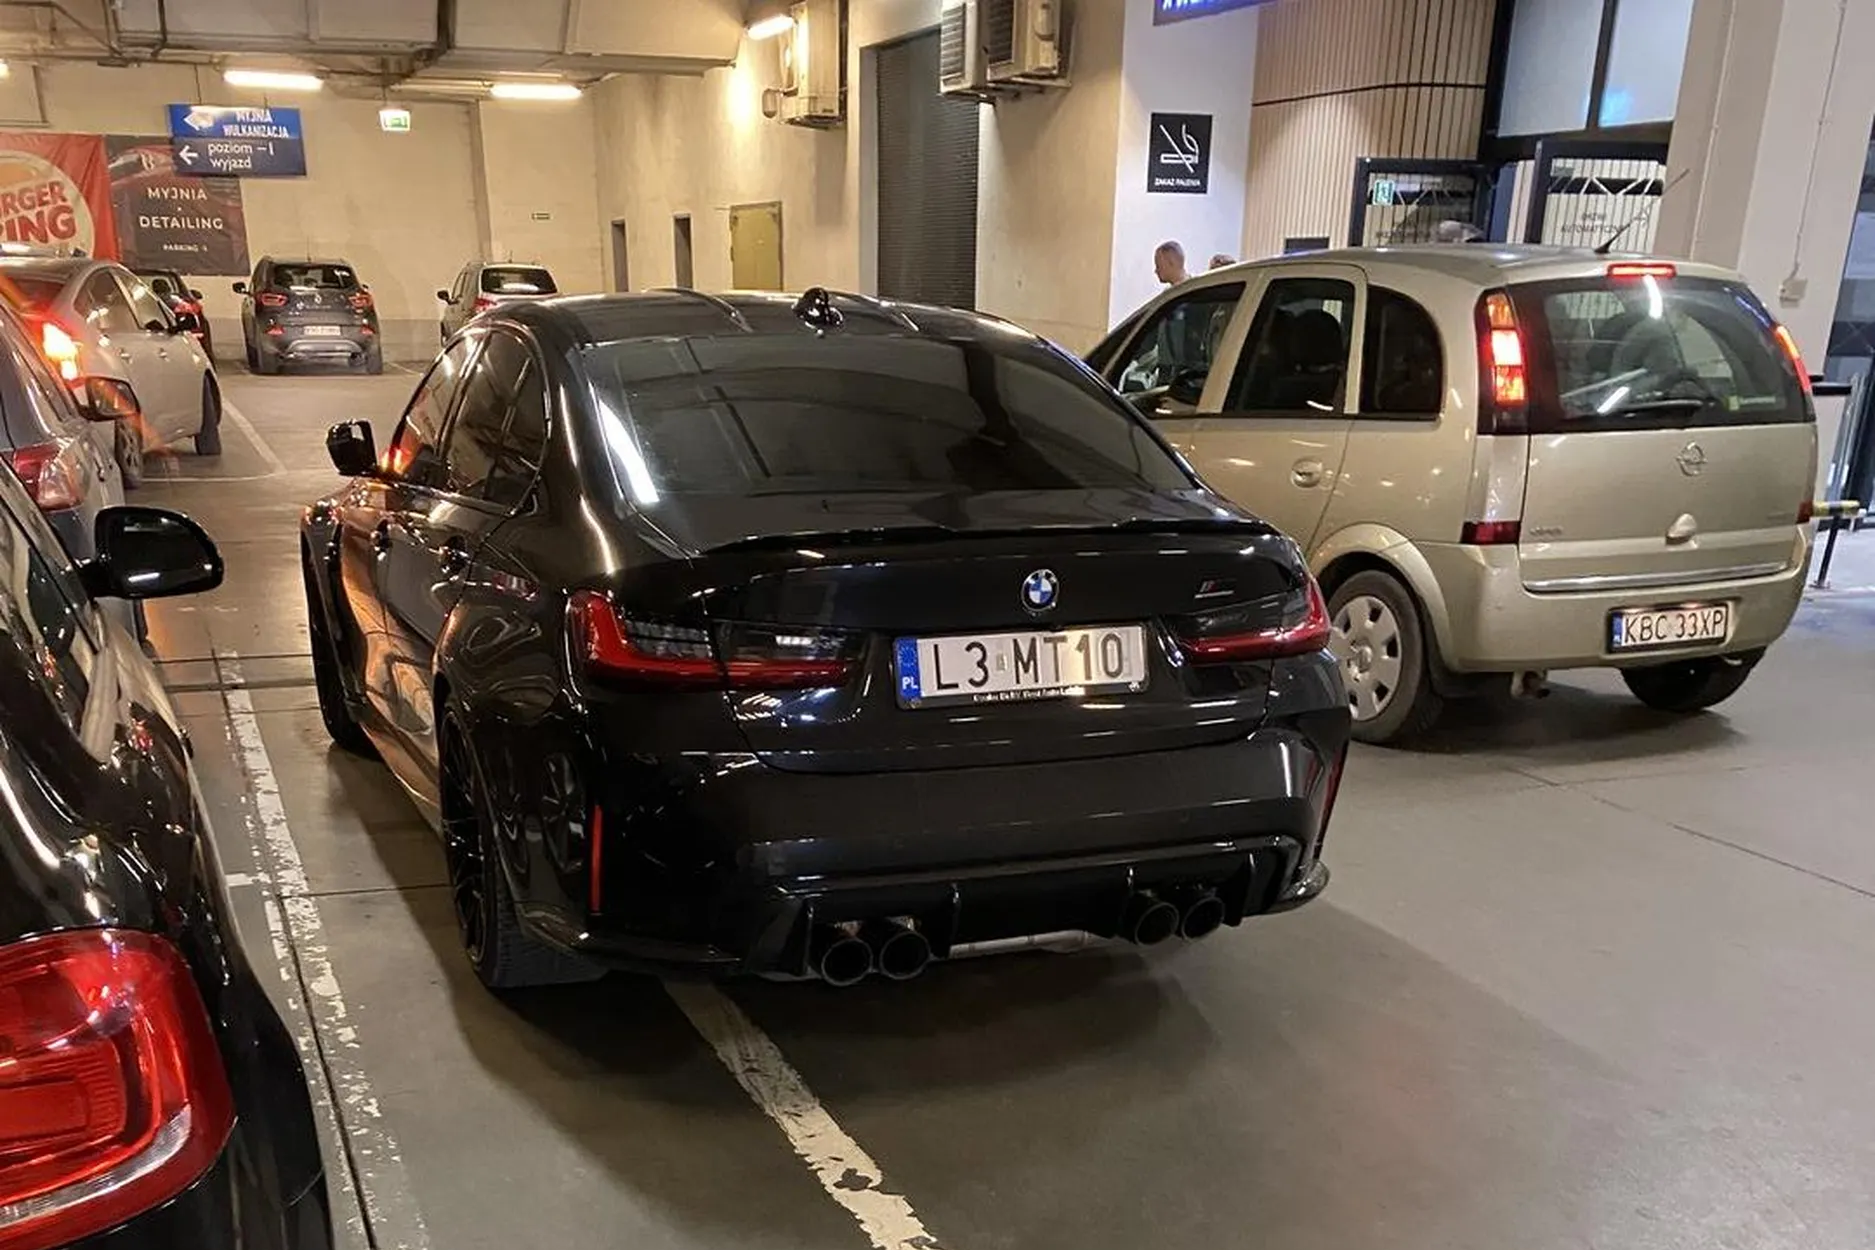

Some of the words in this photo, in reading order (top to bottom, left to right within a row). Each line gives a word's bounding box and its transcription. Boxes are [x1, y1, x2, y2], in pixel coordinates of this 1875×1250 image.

[222, 124, 290, 138] WULKANIZACJA
[207, 143, 253, 157] poziom
[209, 156, 253, 171] wyjazd
[1154, 177, 1174, 186] ZAKAZ
[0, 181, 68, 217] RGER
[0, 204, 77, 244] ING
[139, 215, 224, 230] DETAILING
[163, 244, 199, 253] PARKING
[1624, 614, 1667, 644] KBC
[1675, 609, 1724, 639] 33XP
[933, 641, 989, 691] L3
[1012, 632, 1124, 685] MT10
[902, 675, 919, 690] PL
